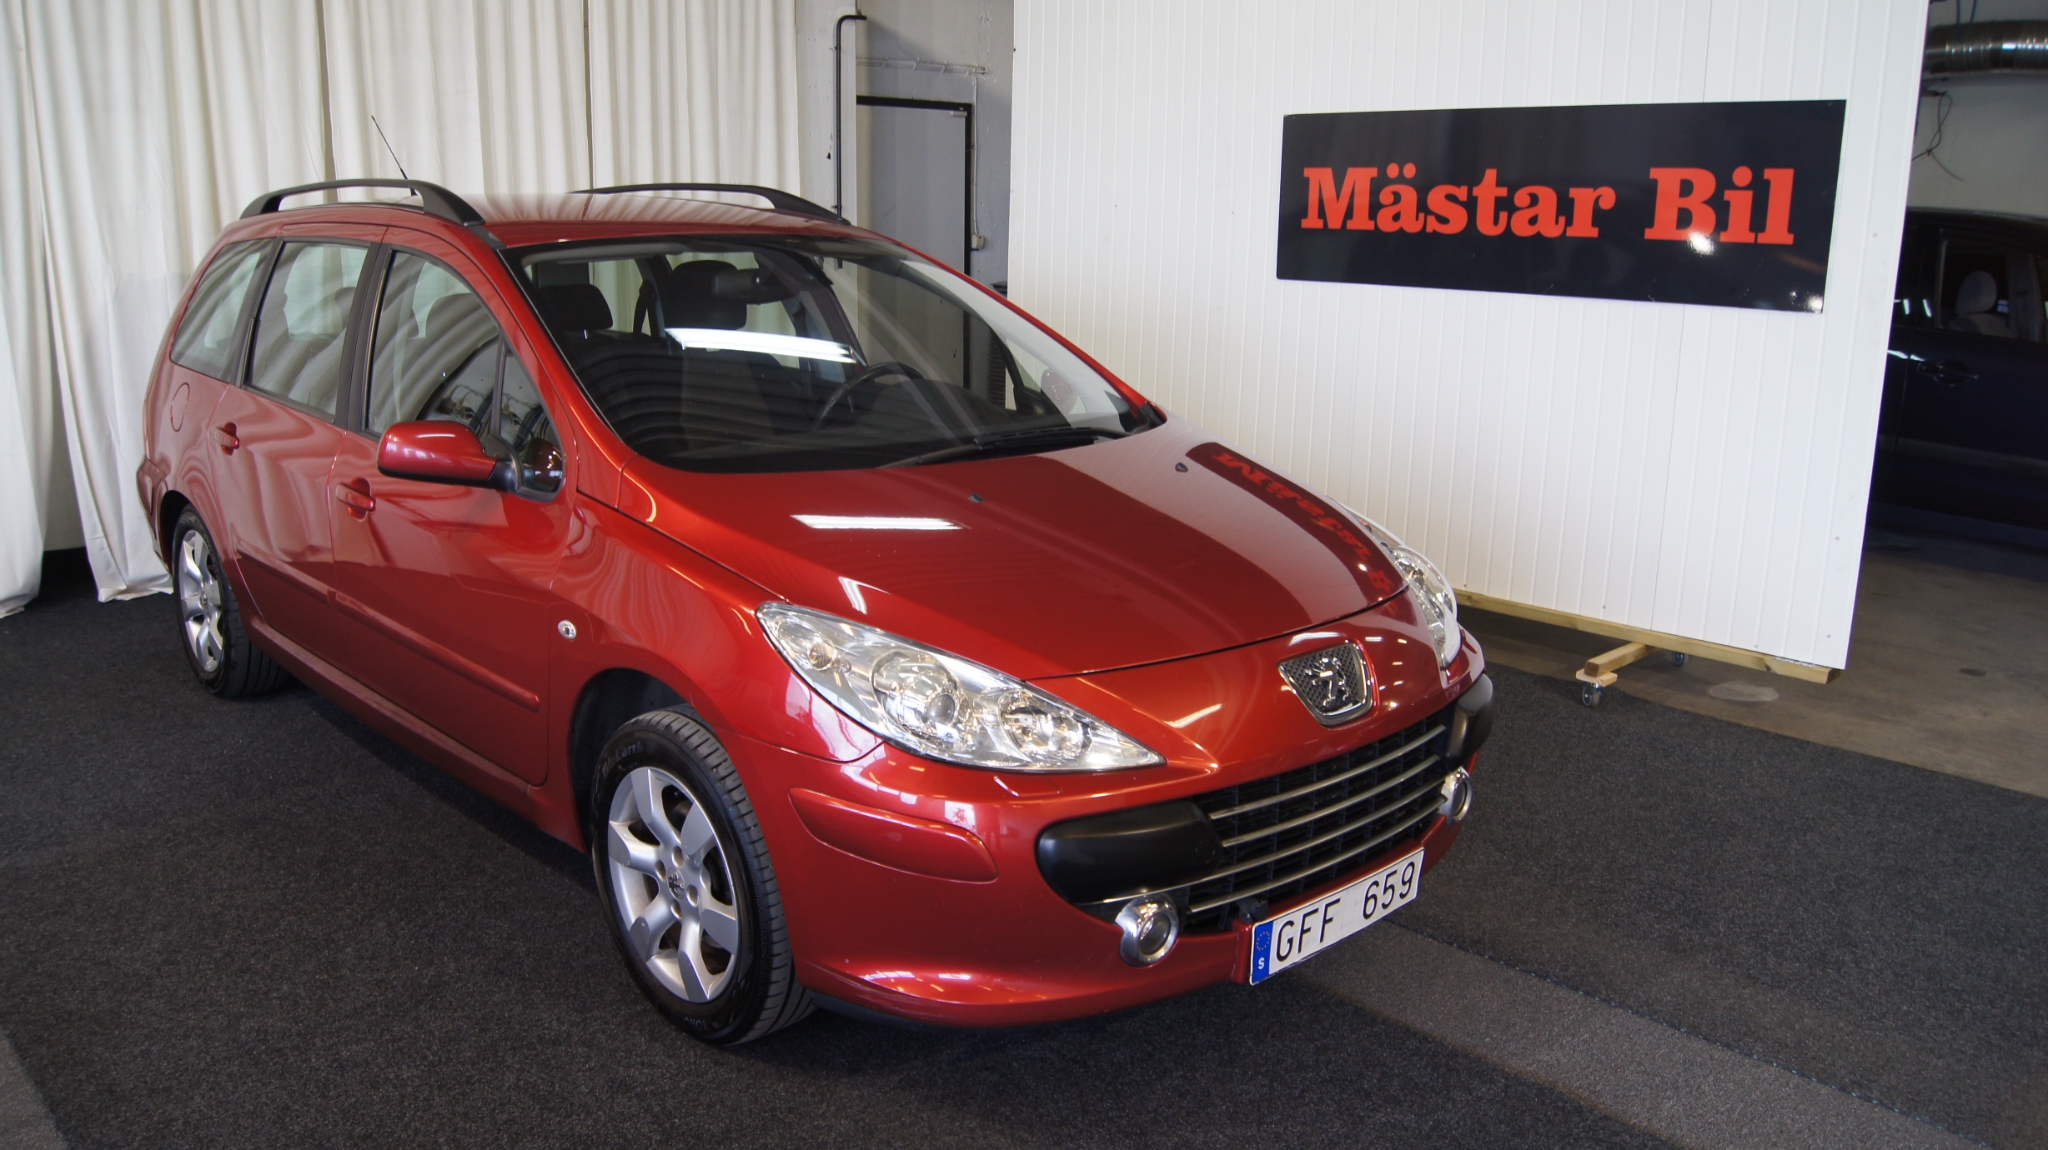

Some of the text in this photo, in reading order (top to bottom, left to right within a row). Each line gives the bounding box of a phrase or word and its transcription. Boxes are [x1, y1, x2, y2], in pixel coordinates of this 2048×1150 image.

[1301, 162, 1794, 245] Mästar Bil
[1276, 861, 1416, 962] GFF 659
[1258, 957, 1265, 970] S
